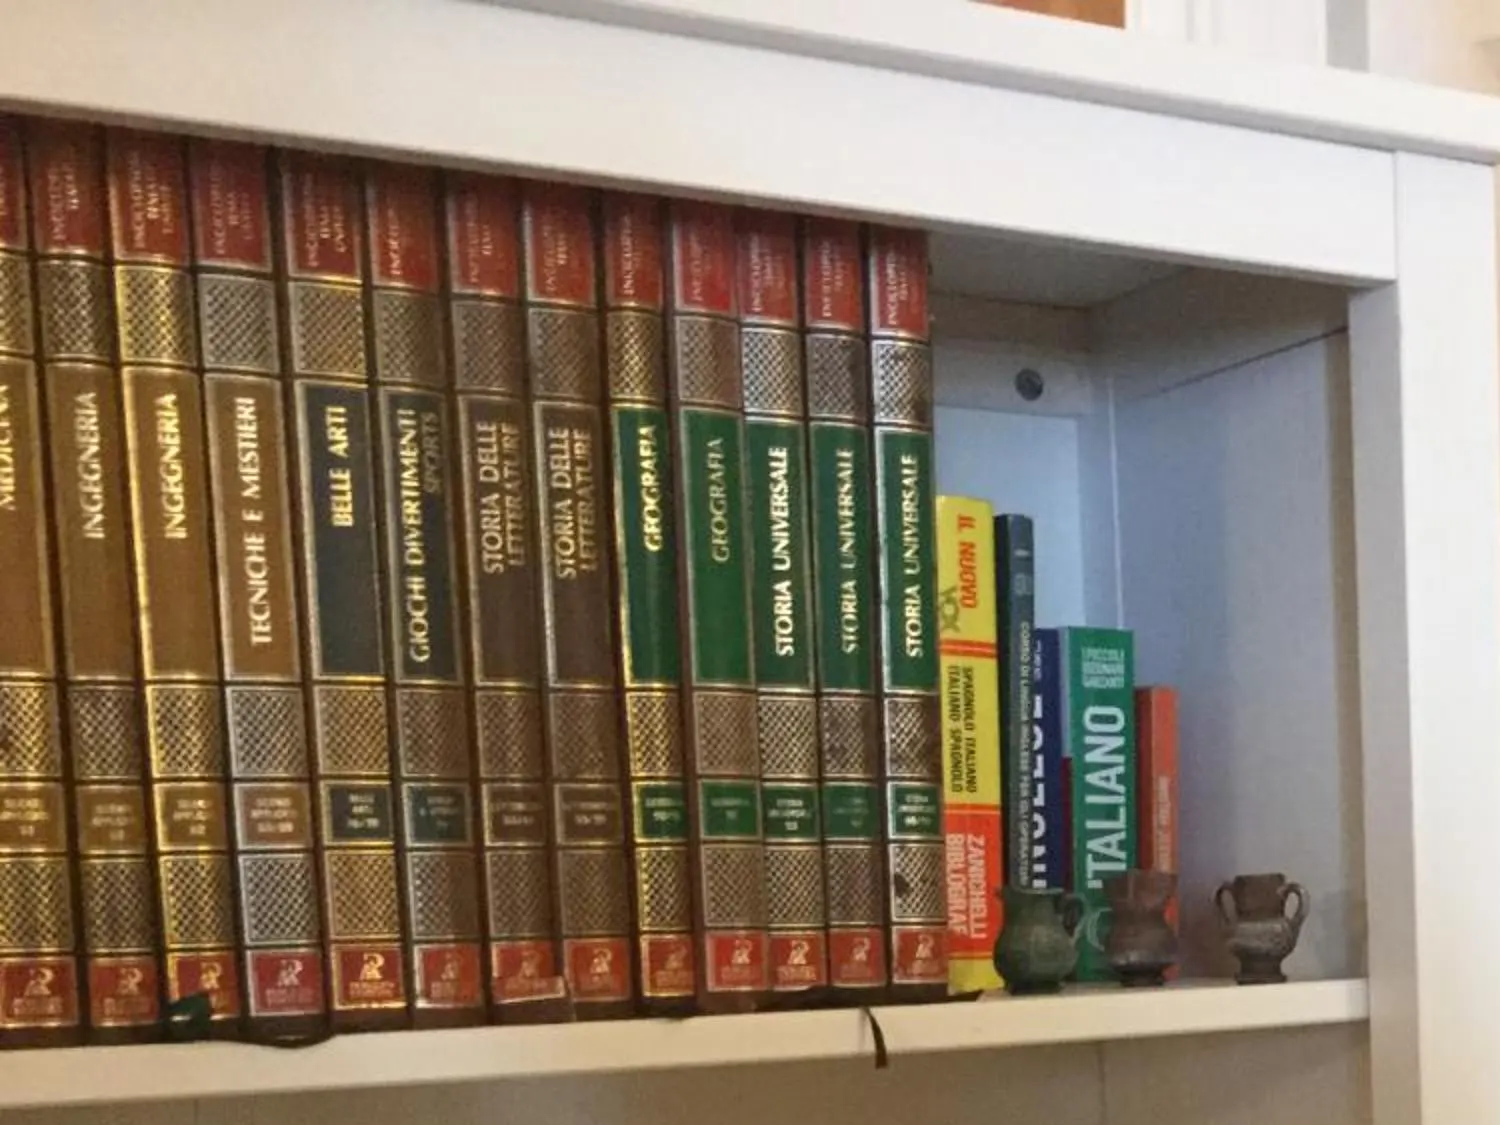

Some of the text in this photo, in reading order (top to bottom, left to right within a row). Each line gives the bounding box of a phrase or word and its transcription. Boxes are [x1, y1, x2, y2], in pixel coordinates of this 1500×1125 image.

[74, 392, 105, 539] INGEGNERIA
[155, 393, 188, 539] INGEGNERIA
[234, 396, 272, 645] TECNICHE E MESTIERI
[325, 405, 354, 527] BELLE ARTI
[420, 411, 440, 494] SPORTS
[476, 421, 504, 574] STORIA DELLE
[501, 422, 526, 566] LETTERATURE
[550, 426, 577, 580] STORIA DELLE
[573, 428, 598, 572] LETTERATURE
[637, 424, 664, 552] GEOGRAFIA
[706, 437, 730, 563] GEOGRAFIA
[397, 408, 431, 663] GIOCHI DIVERTIMENTI
[768, 447, 794, 657] STORIA UNIVERSALE
[836, 449, 860, 654] STORIA UNIVERSALE
[901, 454, 924, 658] STORIA UNIVERSALE
[958, 513, 978, 609] IL NUOVO
[1019, 621, 1031, 662] CORSO
[948, 665, 963, 793] ITALIANO SPAGNOLO
[963, 666, 977, 794] SPAGNOLO ITALIANO
[967, 833, 988, 939] ZANICHELLI
